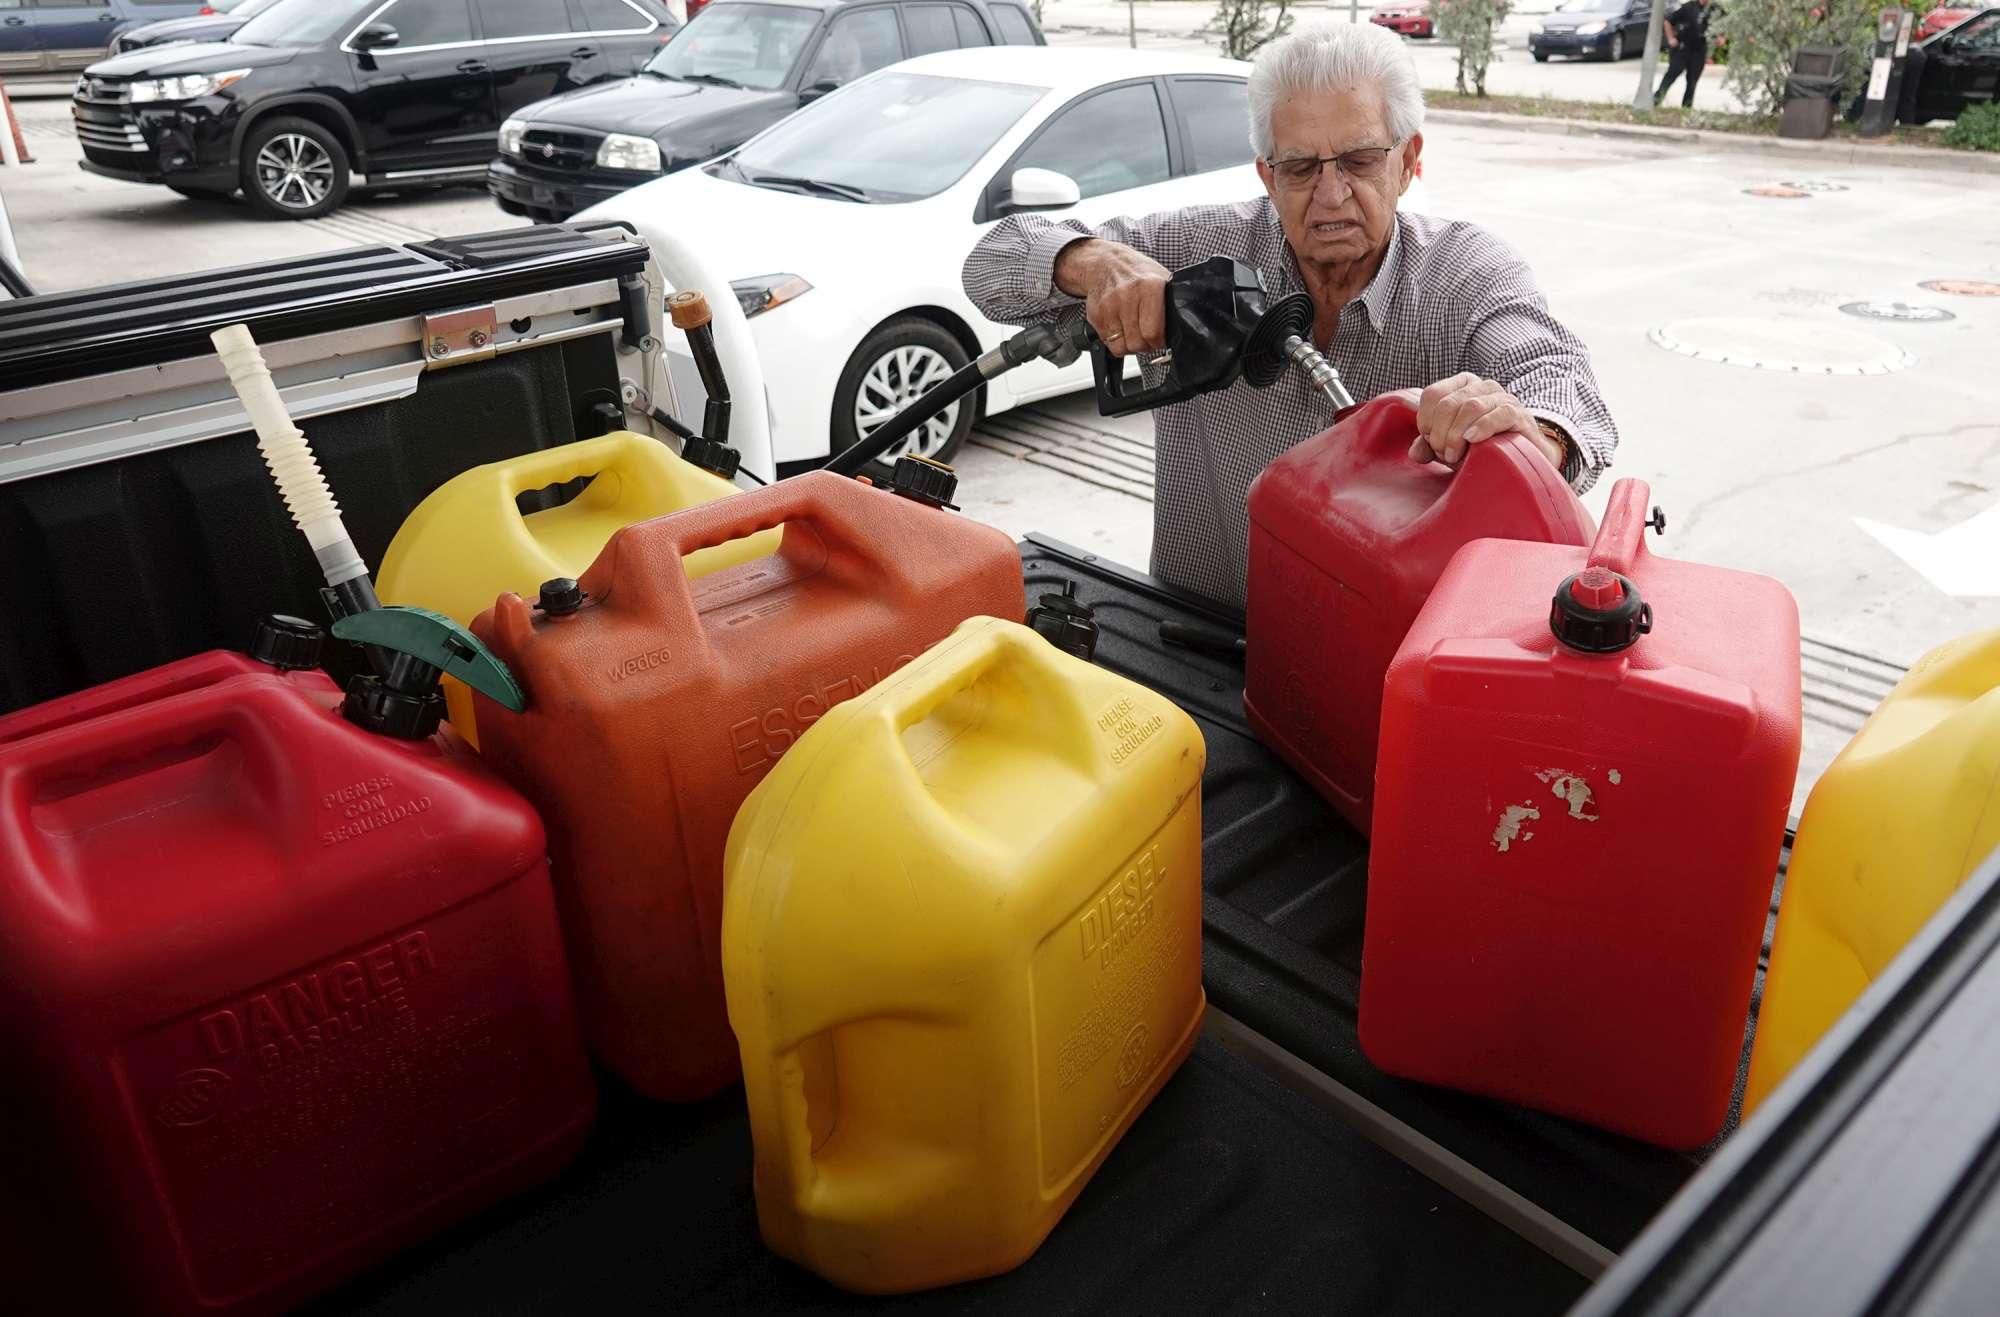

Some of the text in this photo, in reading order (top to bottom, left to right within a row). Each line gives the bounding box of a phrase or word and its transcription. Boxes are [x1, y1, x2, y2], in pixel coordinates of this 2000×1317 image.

[607, 646, 672, 682] wedco
[1098, 697, 1135, 732] PIENSE
[1114, 712, 1137, 738] CON
[1111, 713, 1164, 763] SEGURIDAD
[345, 793, 386, 818] CON
[1080, 844, 1167, 959] DIESEL
[199, 930, 434, 1061] DANGER
[257, 988, 409, 1070] GASOLINE
